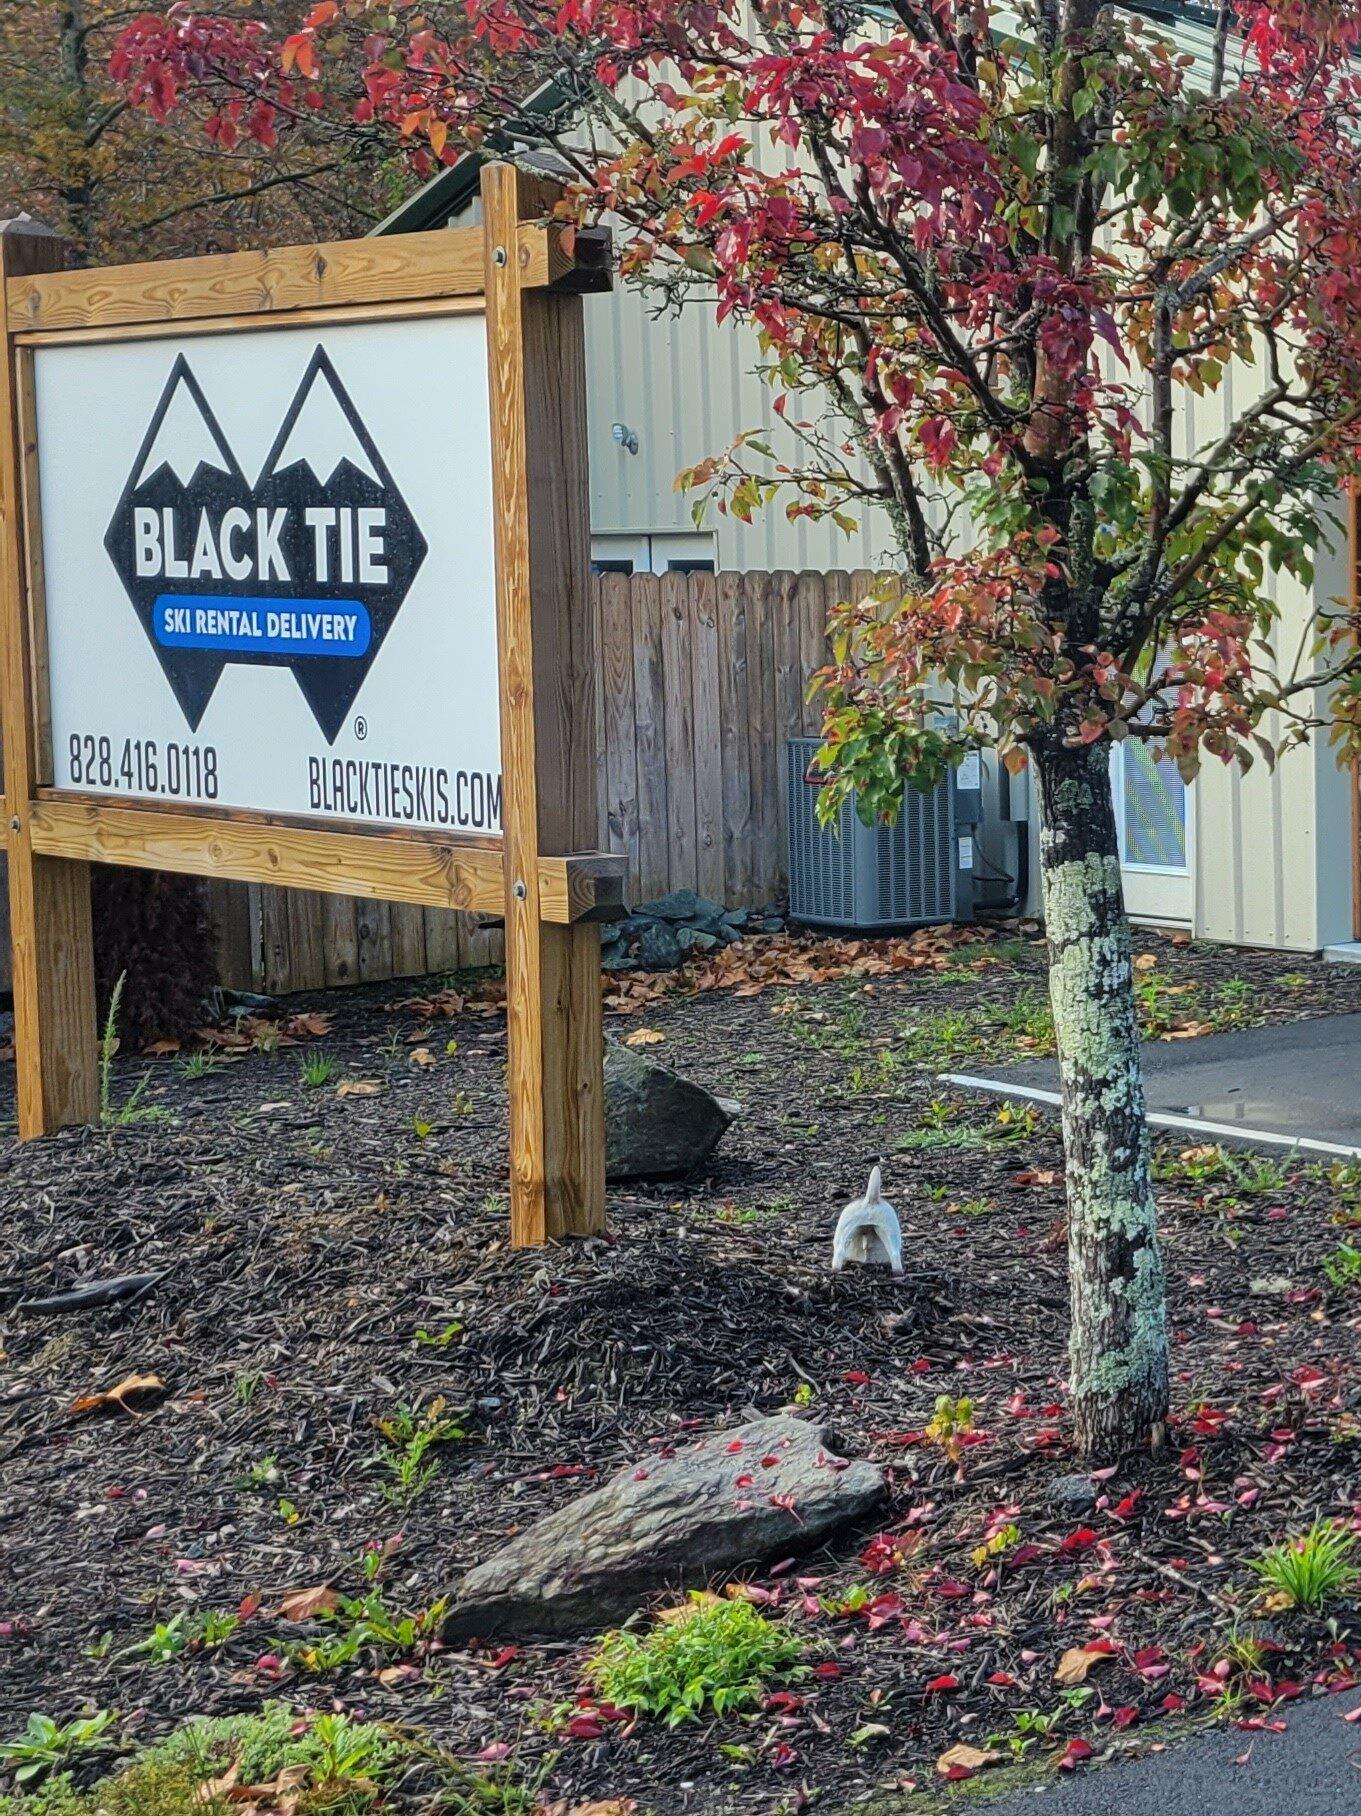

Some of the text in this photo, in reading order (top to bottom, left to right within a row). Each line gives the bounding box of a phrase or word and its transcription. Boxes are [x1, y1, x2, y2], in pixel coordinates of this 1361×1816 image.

[134, 506, 389, 584] BLACK TIE
[164, 608, 358, 642] SKI RENTAL DELIVERY
[69, 733, 219, 799] 828.416.0118
[308, 756, 503, 830] BLACKTIESKIS.COM
